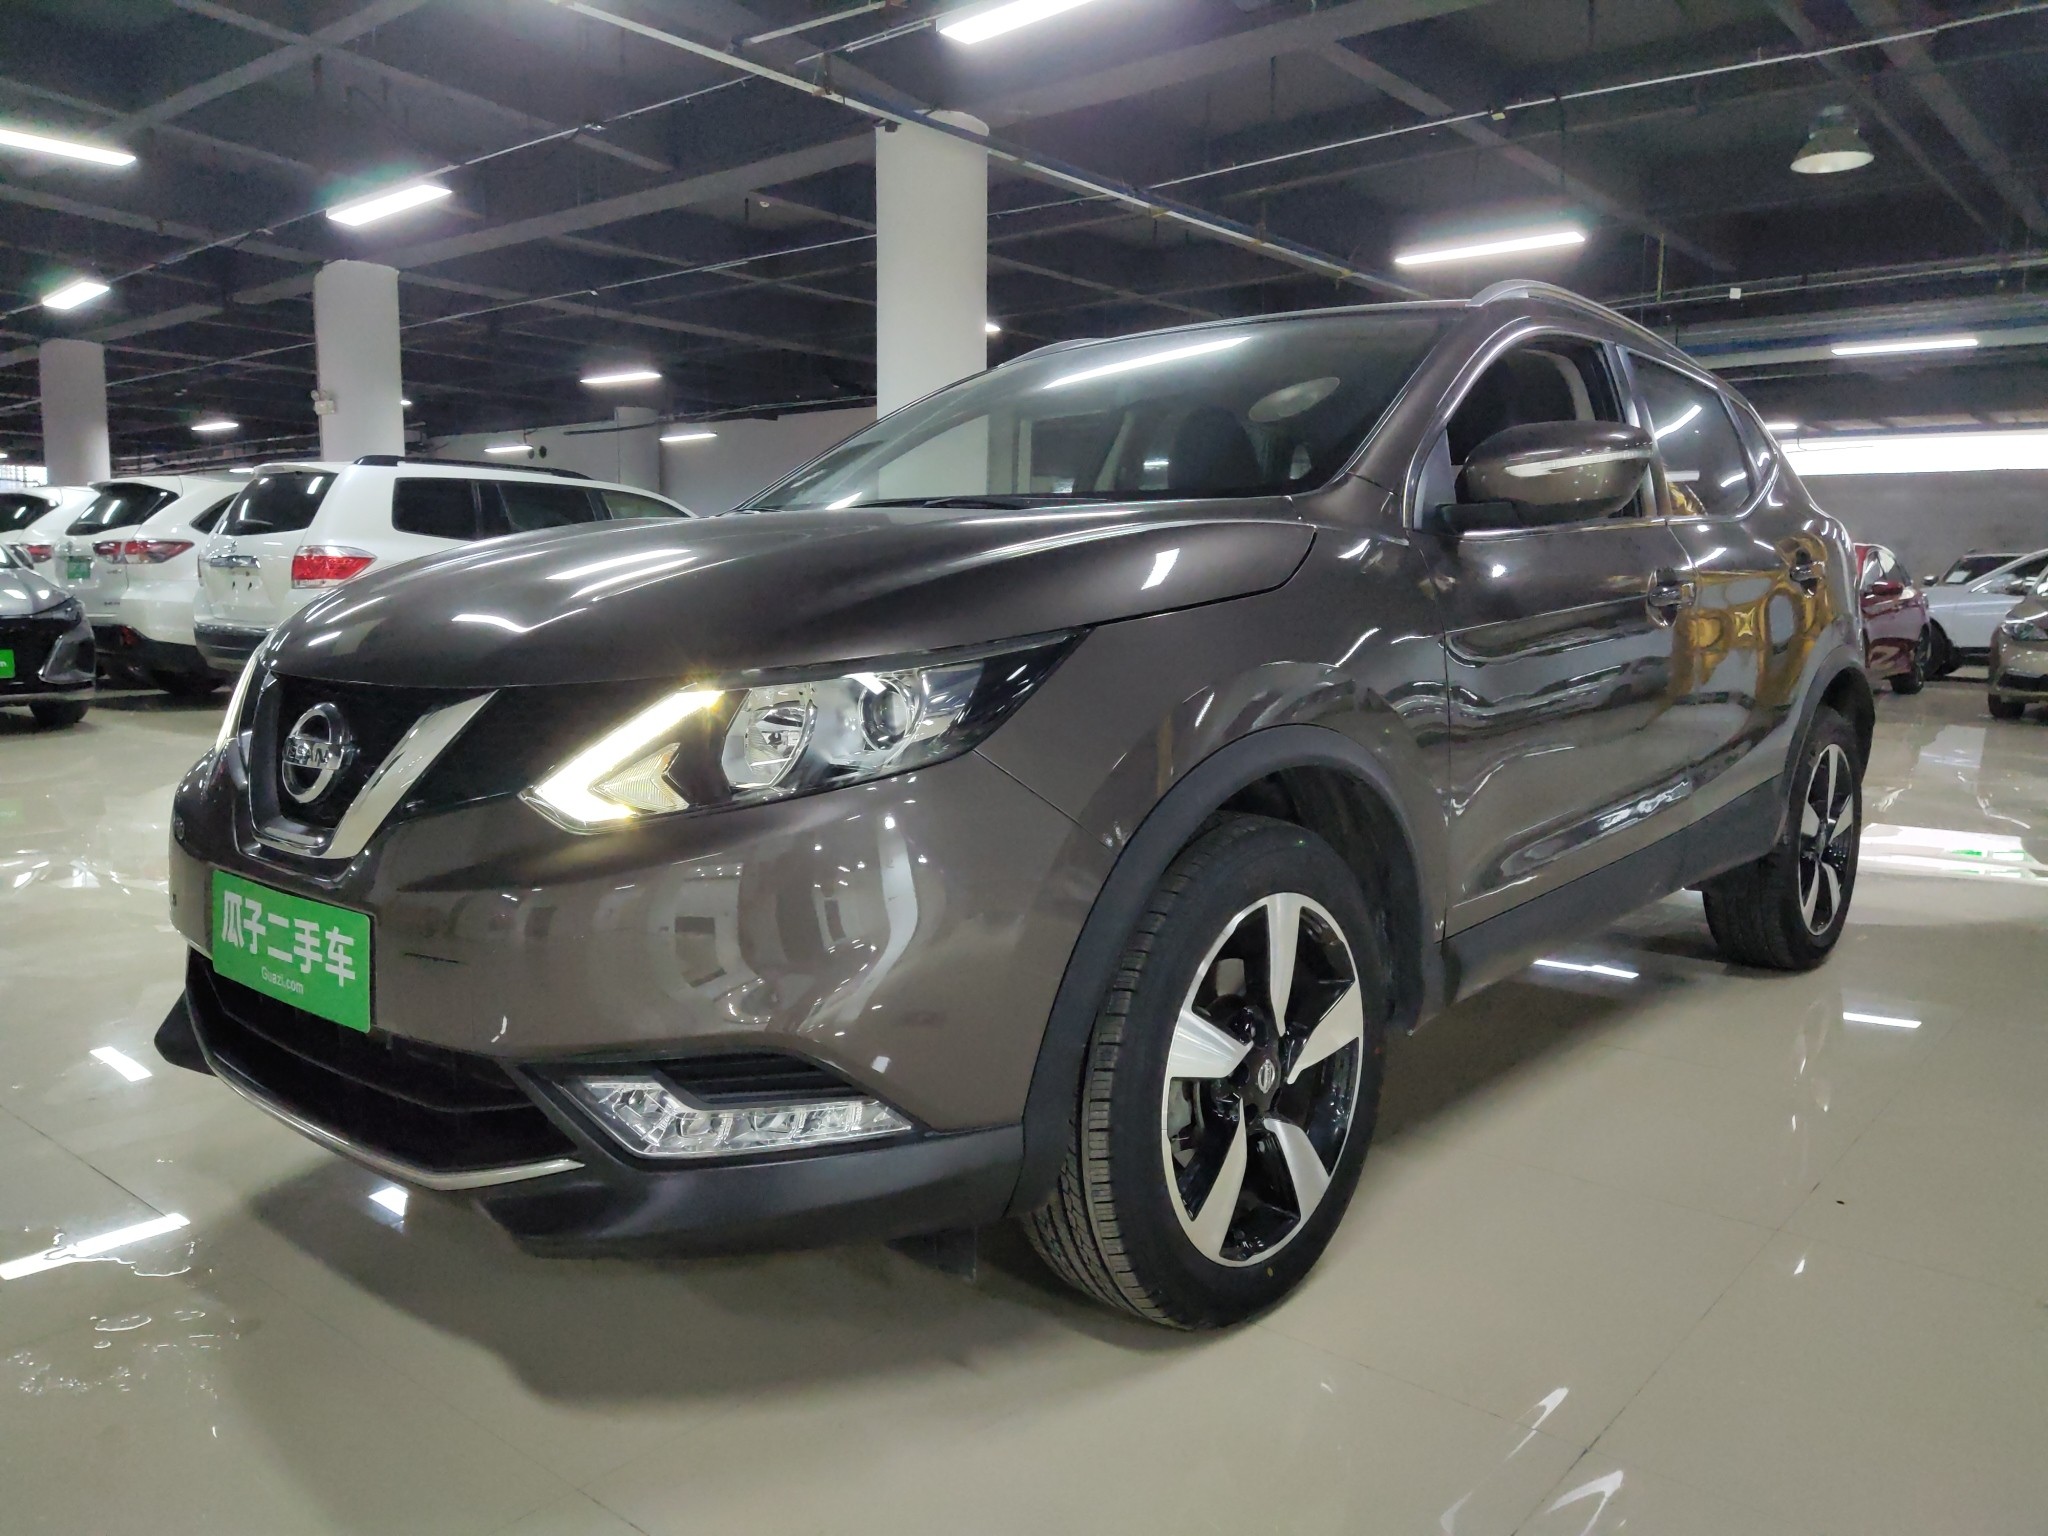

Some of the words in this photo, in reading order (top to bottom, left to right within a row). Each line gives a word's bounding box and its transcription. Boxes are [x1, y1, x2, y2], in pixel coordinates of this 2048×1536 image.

[282, 744, 330, 769] ISSAN
[222, 890, 356, 987] 瓜子二手车
[261, 966, 304, 995] Guazi.com
